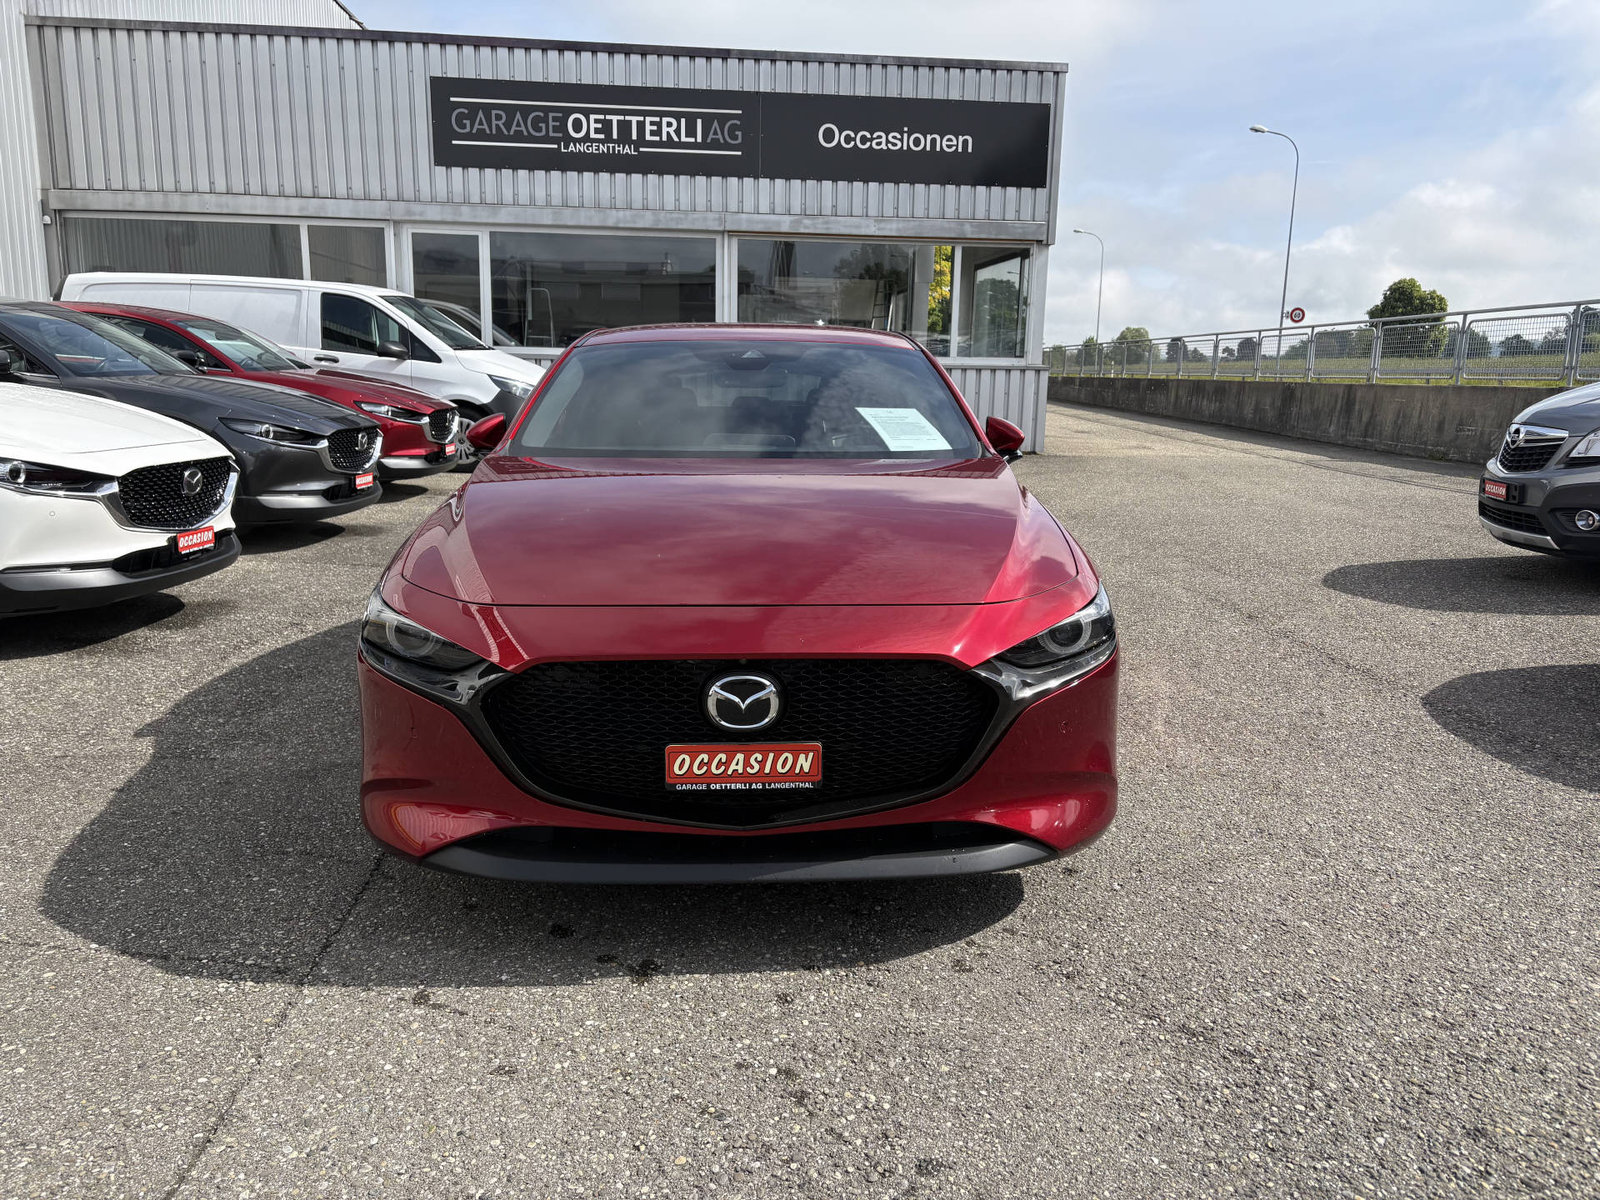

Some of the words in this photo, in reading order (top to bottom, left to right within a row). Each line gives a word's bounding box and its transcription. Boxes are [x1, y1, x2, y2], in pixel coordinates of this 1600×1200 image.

[451, 108, 562, 137] GARAGE
[567, 113, 702, 142] OETTERLI
[706, 119, 742, 144] AG
[561, 142, 638, 155] LANGENTHAL
[818, 123, 973, 153] Occasionen
[179, 529, 213, 548] OCCASION
[673, 752, 814, 777] OCCASION
[751, 782, 763, 790] AG
[765, 781, 814, 789] LANGENTHAL
